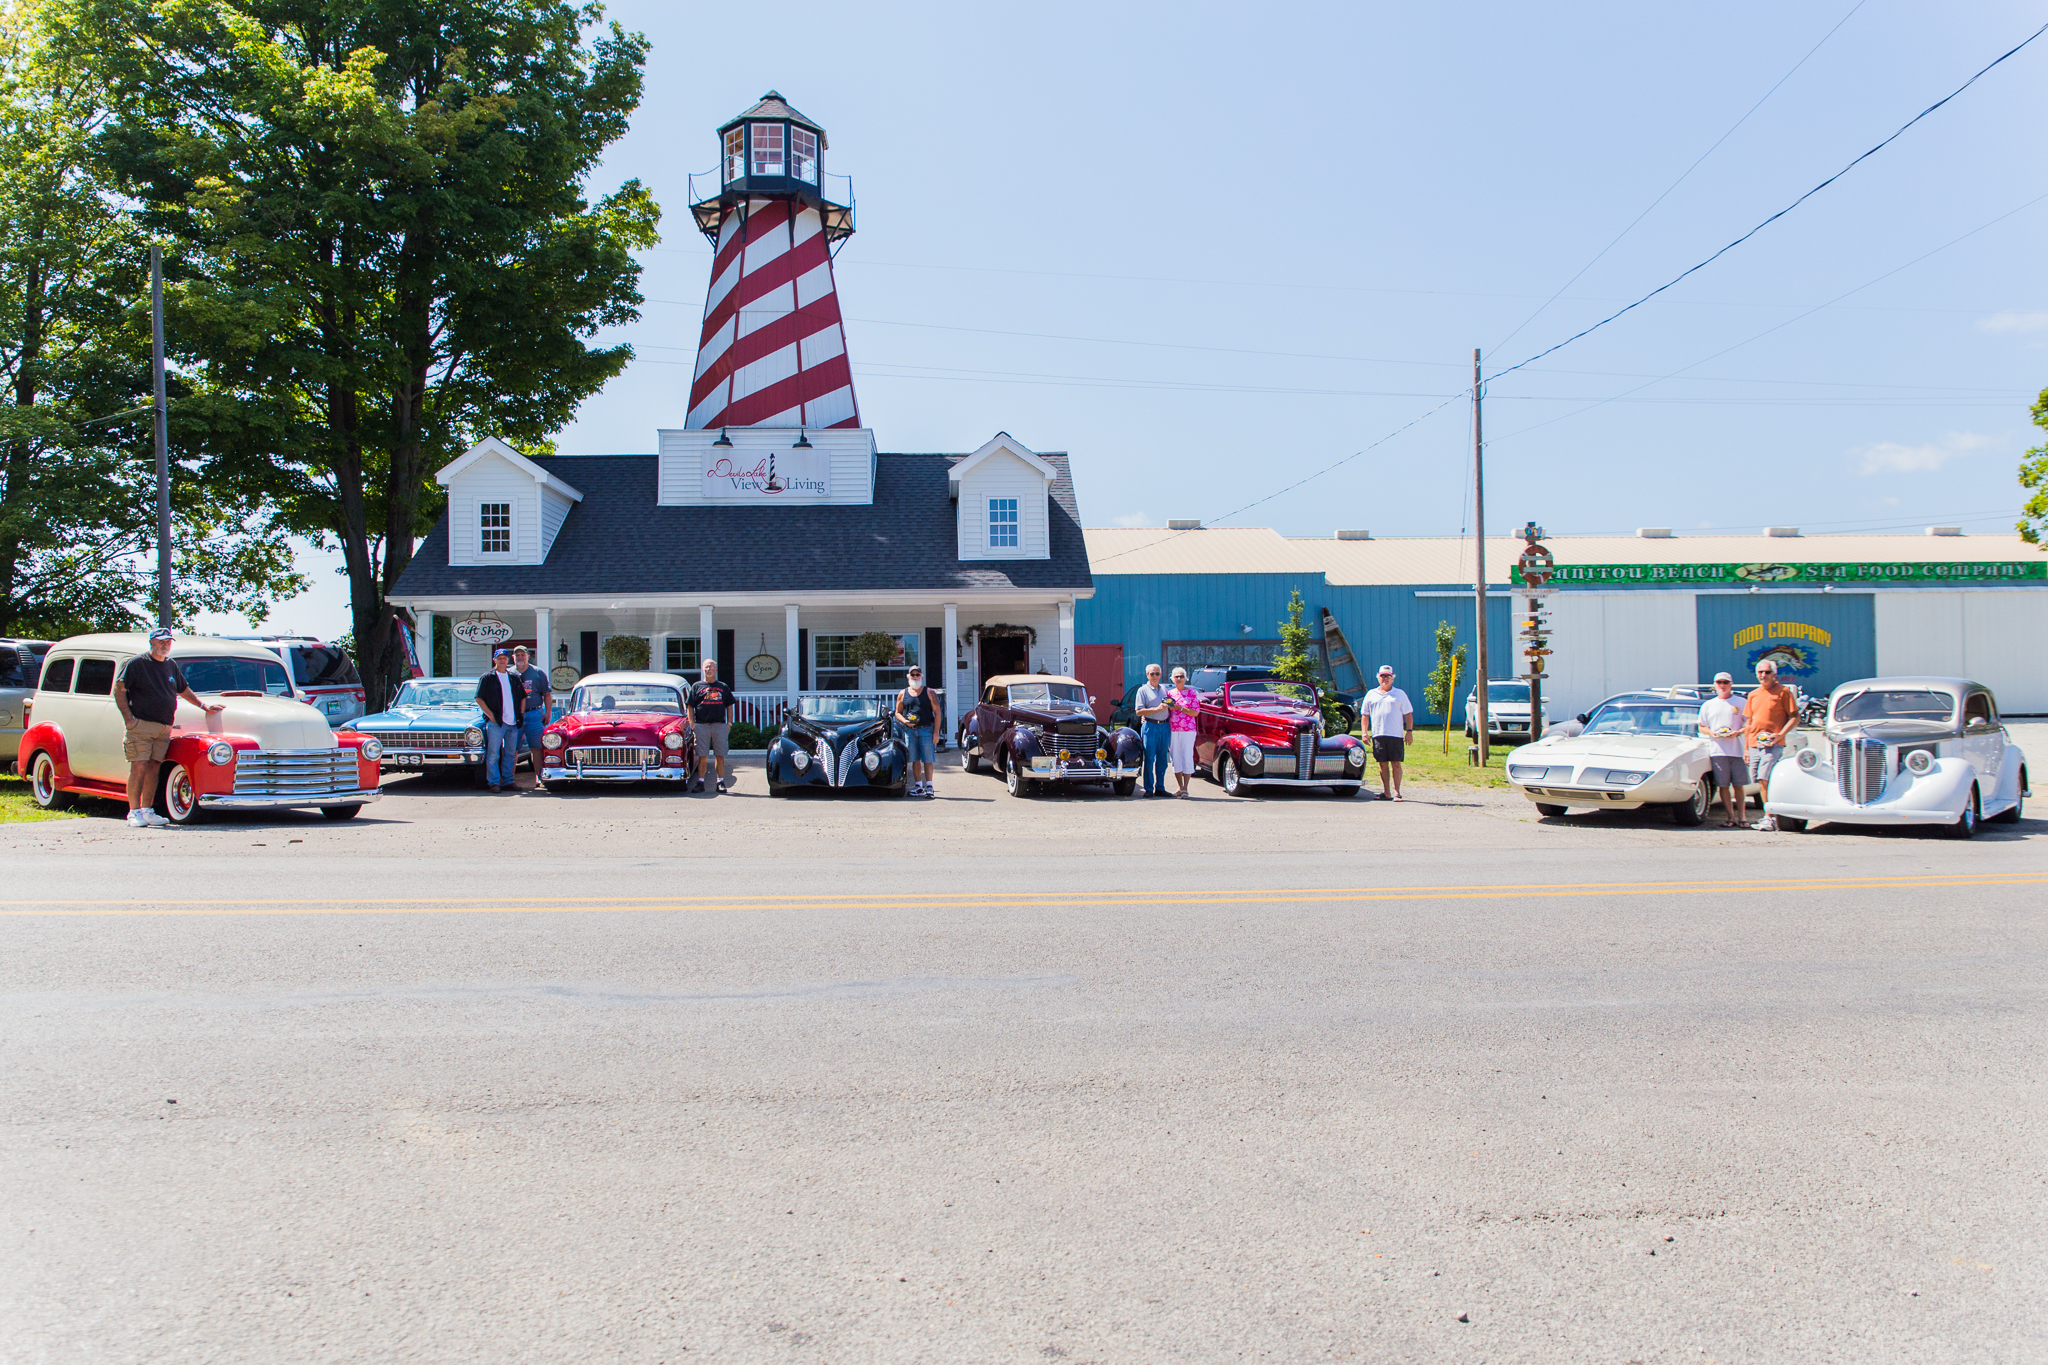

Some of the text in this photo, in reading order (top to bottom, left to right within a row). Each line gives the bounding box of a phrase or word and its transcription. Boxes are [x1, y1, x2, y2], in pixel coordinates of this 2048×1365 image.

[707, 458, 746, 478] Devils
[730, 477, 825, 494] View Living
[1549, 564, 2029, 580] ANITOU BEACH SEA FOOD COMPANY
[457, 625, 509, 639] Gift Shop
[1733, 621, 1831, 650] FOOD COMPANY
[753, 661, 773, 675] Open
[398, 755, 421, 765] SS
